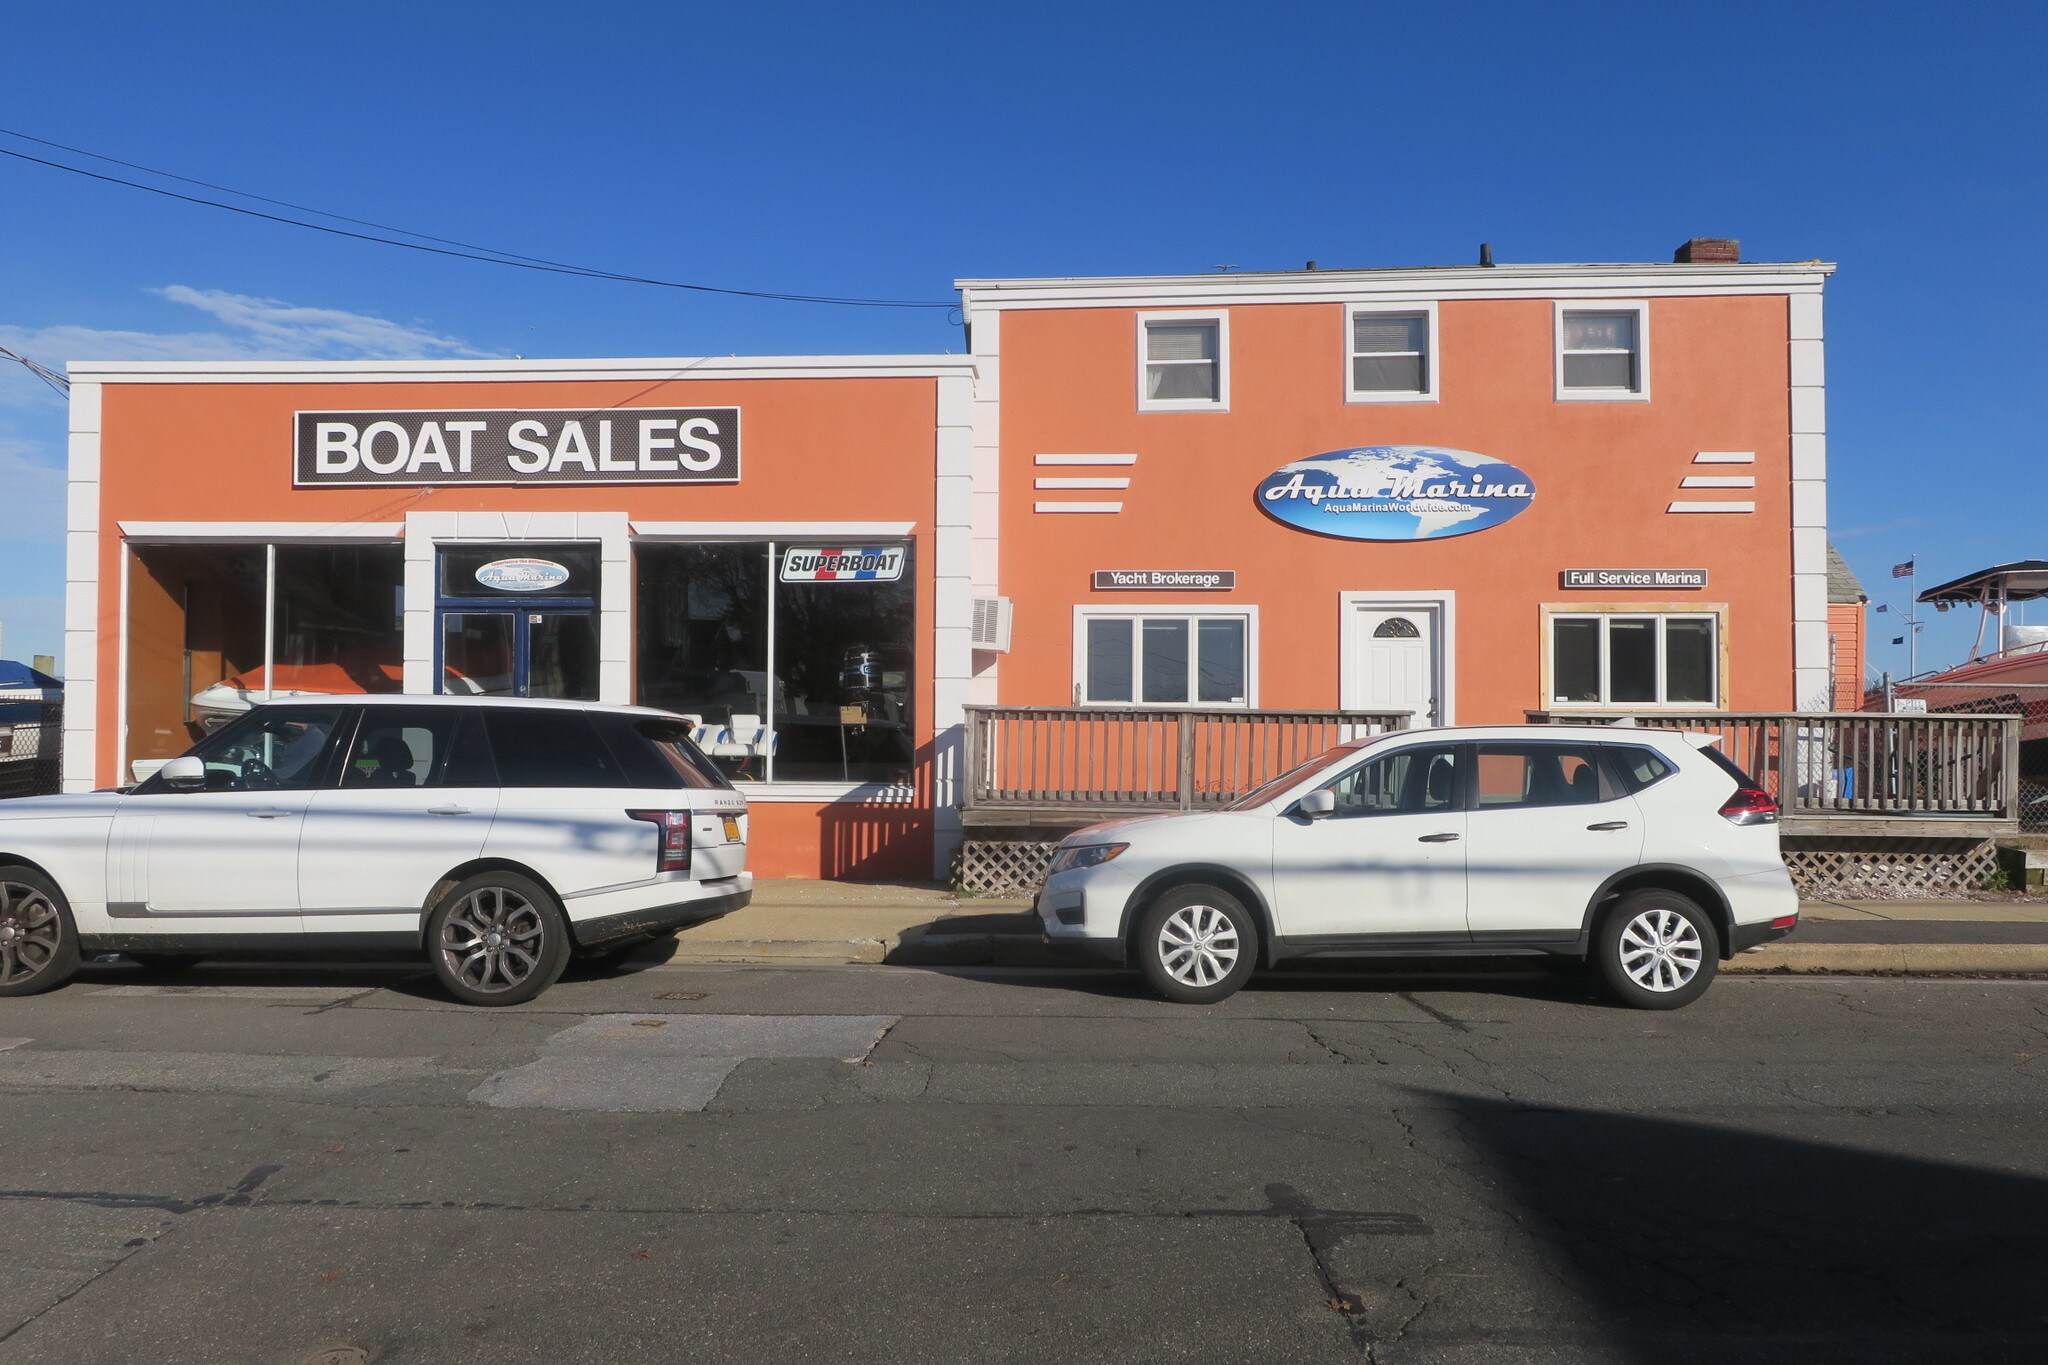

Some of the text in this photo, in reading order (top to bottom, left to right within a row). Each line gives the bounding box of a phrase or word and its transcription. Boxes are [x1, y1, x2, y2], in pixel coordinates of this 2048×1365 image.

[315, 417, 722, 475] BOAT SALES
[1264, 473, 1532, 506] Aqua Marina
[1324, 502, 1472, 514] AquaMarinaWorldwide.com
[788, 554, 899, 572] SUPERBOAT
[481, 571, 564, 584] Aqua Marina
[1110, 572, 1220, 588] Yacht Brokerage
[1570, 571, 1702, 584] Full Service Marina
